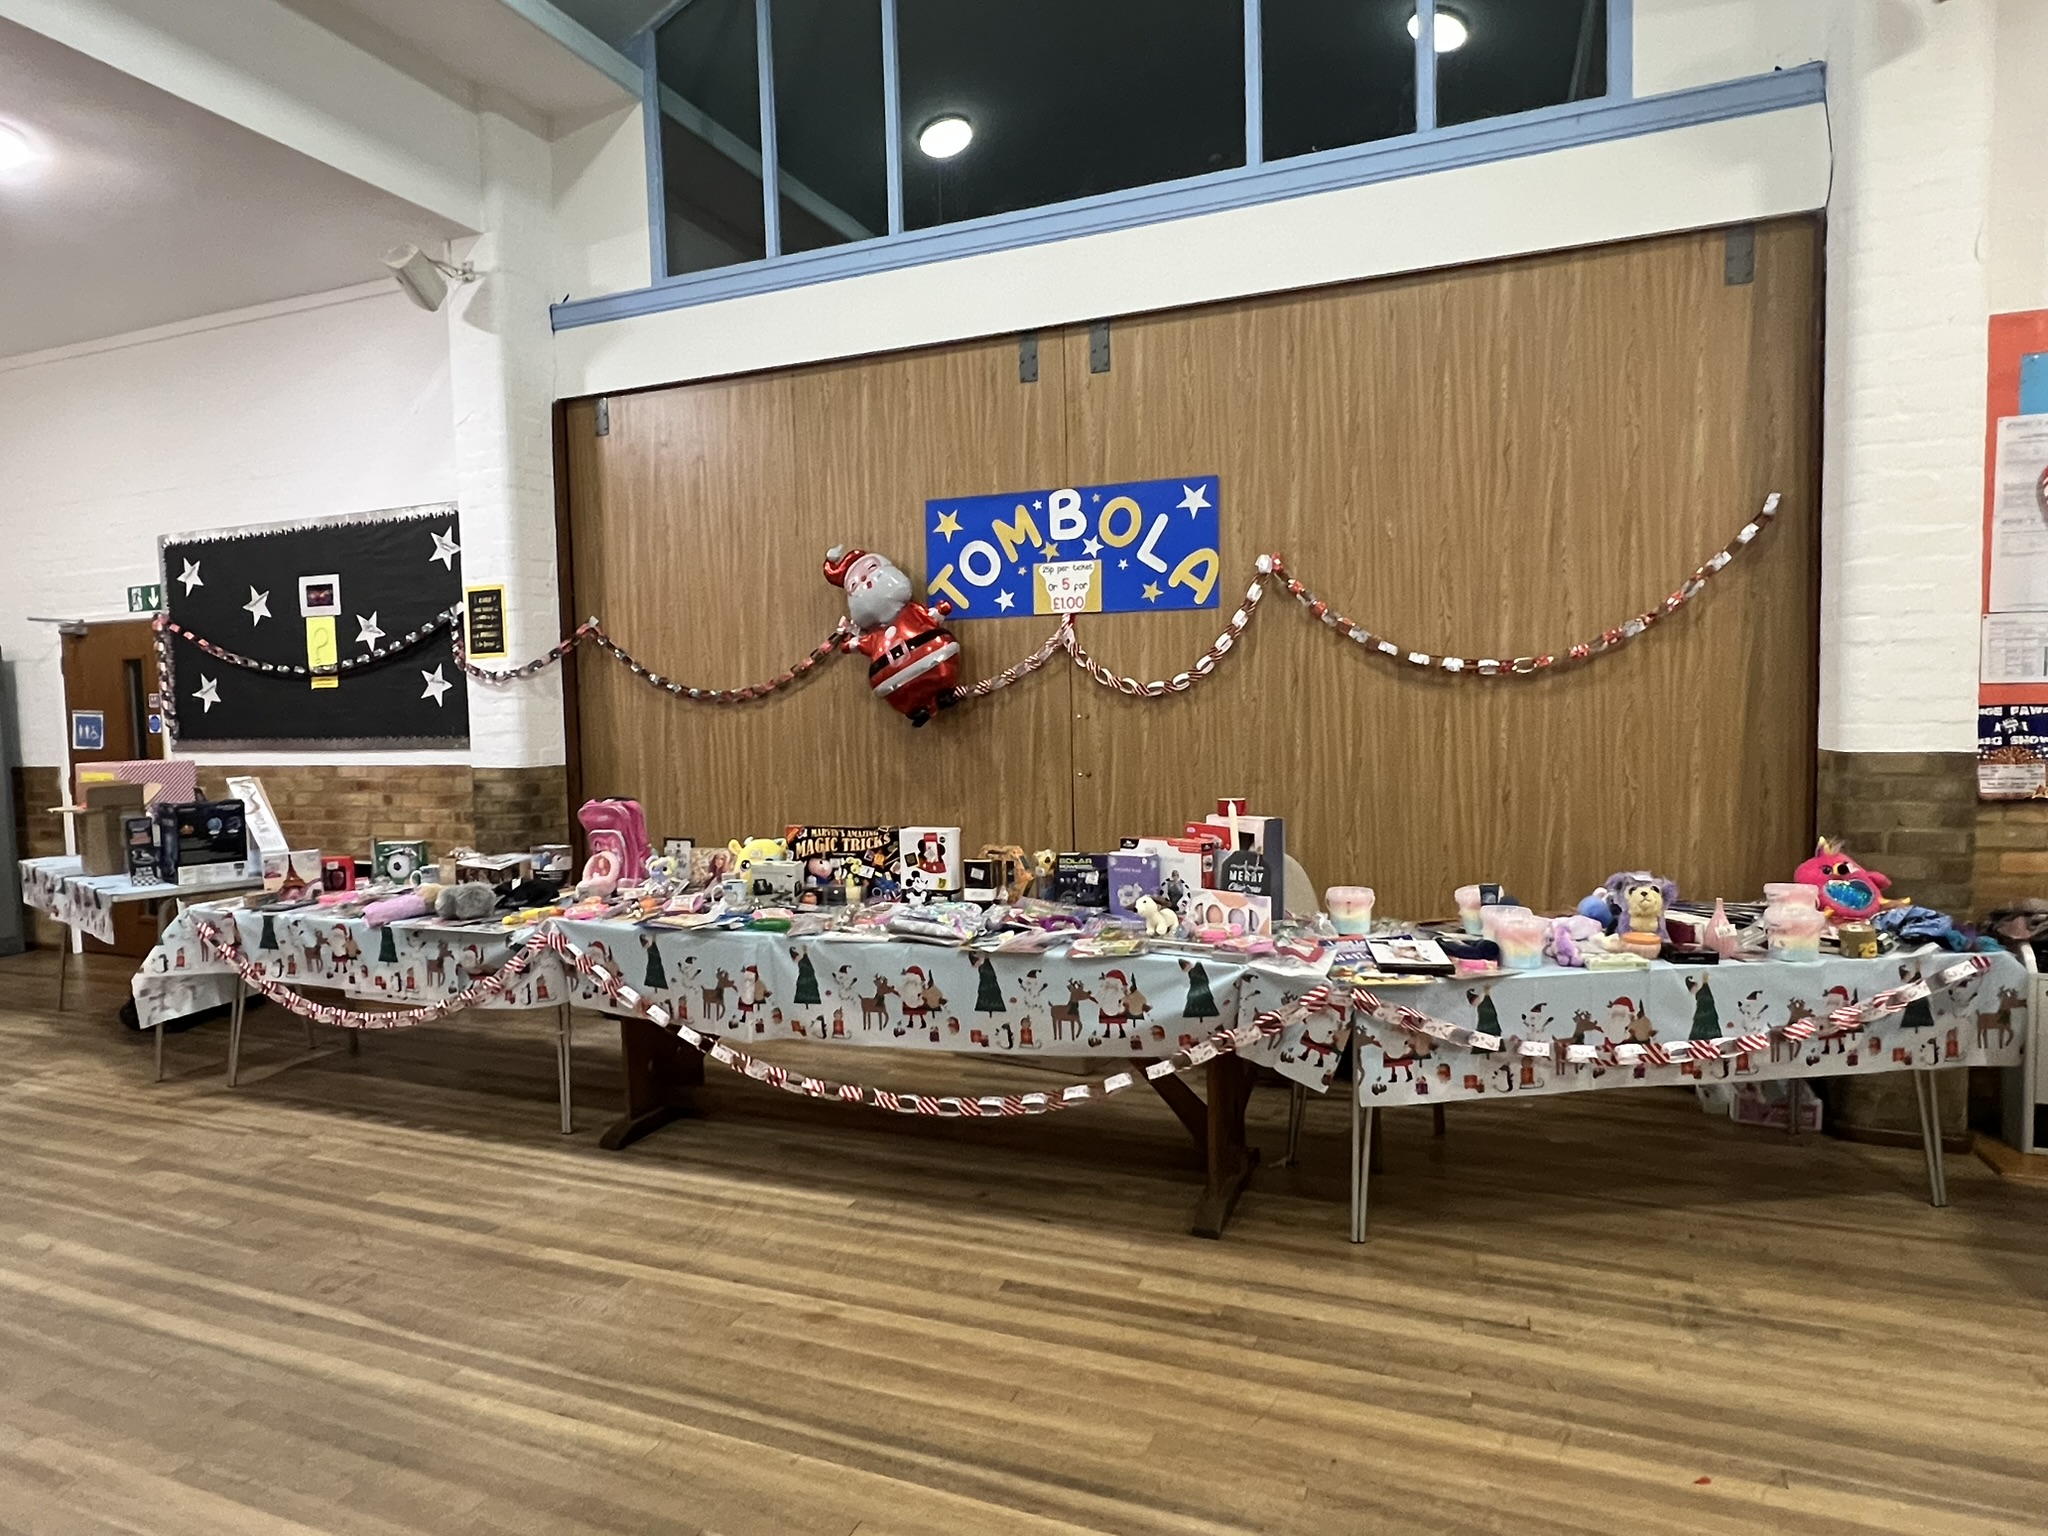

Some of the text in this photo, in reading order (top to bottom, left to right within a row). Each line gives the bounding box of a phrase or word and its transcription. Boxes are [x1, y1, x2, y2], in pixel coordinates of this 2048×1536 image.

[927, 488, 1219, 610] TOMBOLA
[1057, 566, 1069, 574] per
[1062, 577, 1070, 590] 5
[1074, 582, 1088, 592] for
[847, 829, 879, 838] AMAZING
[795, 833, 891, 860] MAGIC TRICKS
